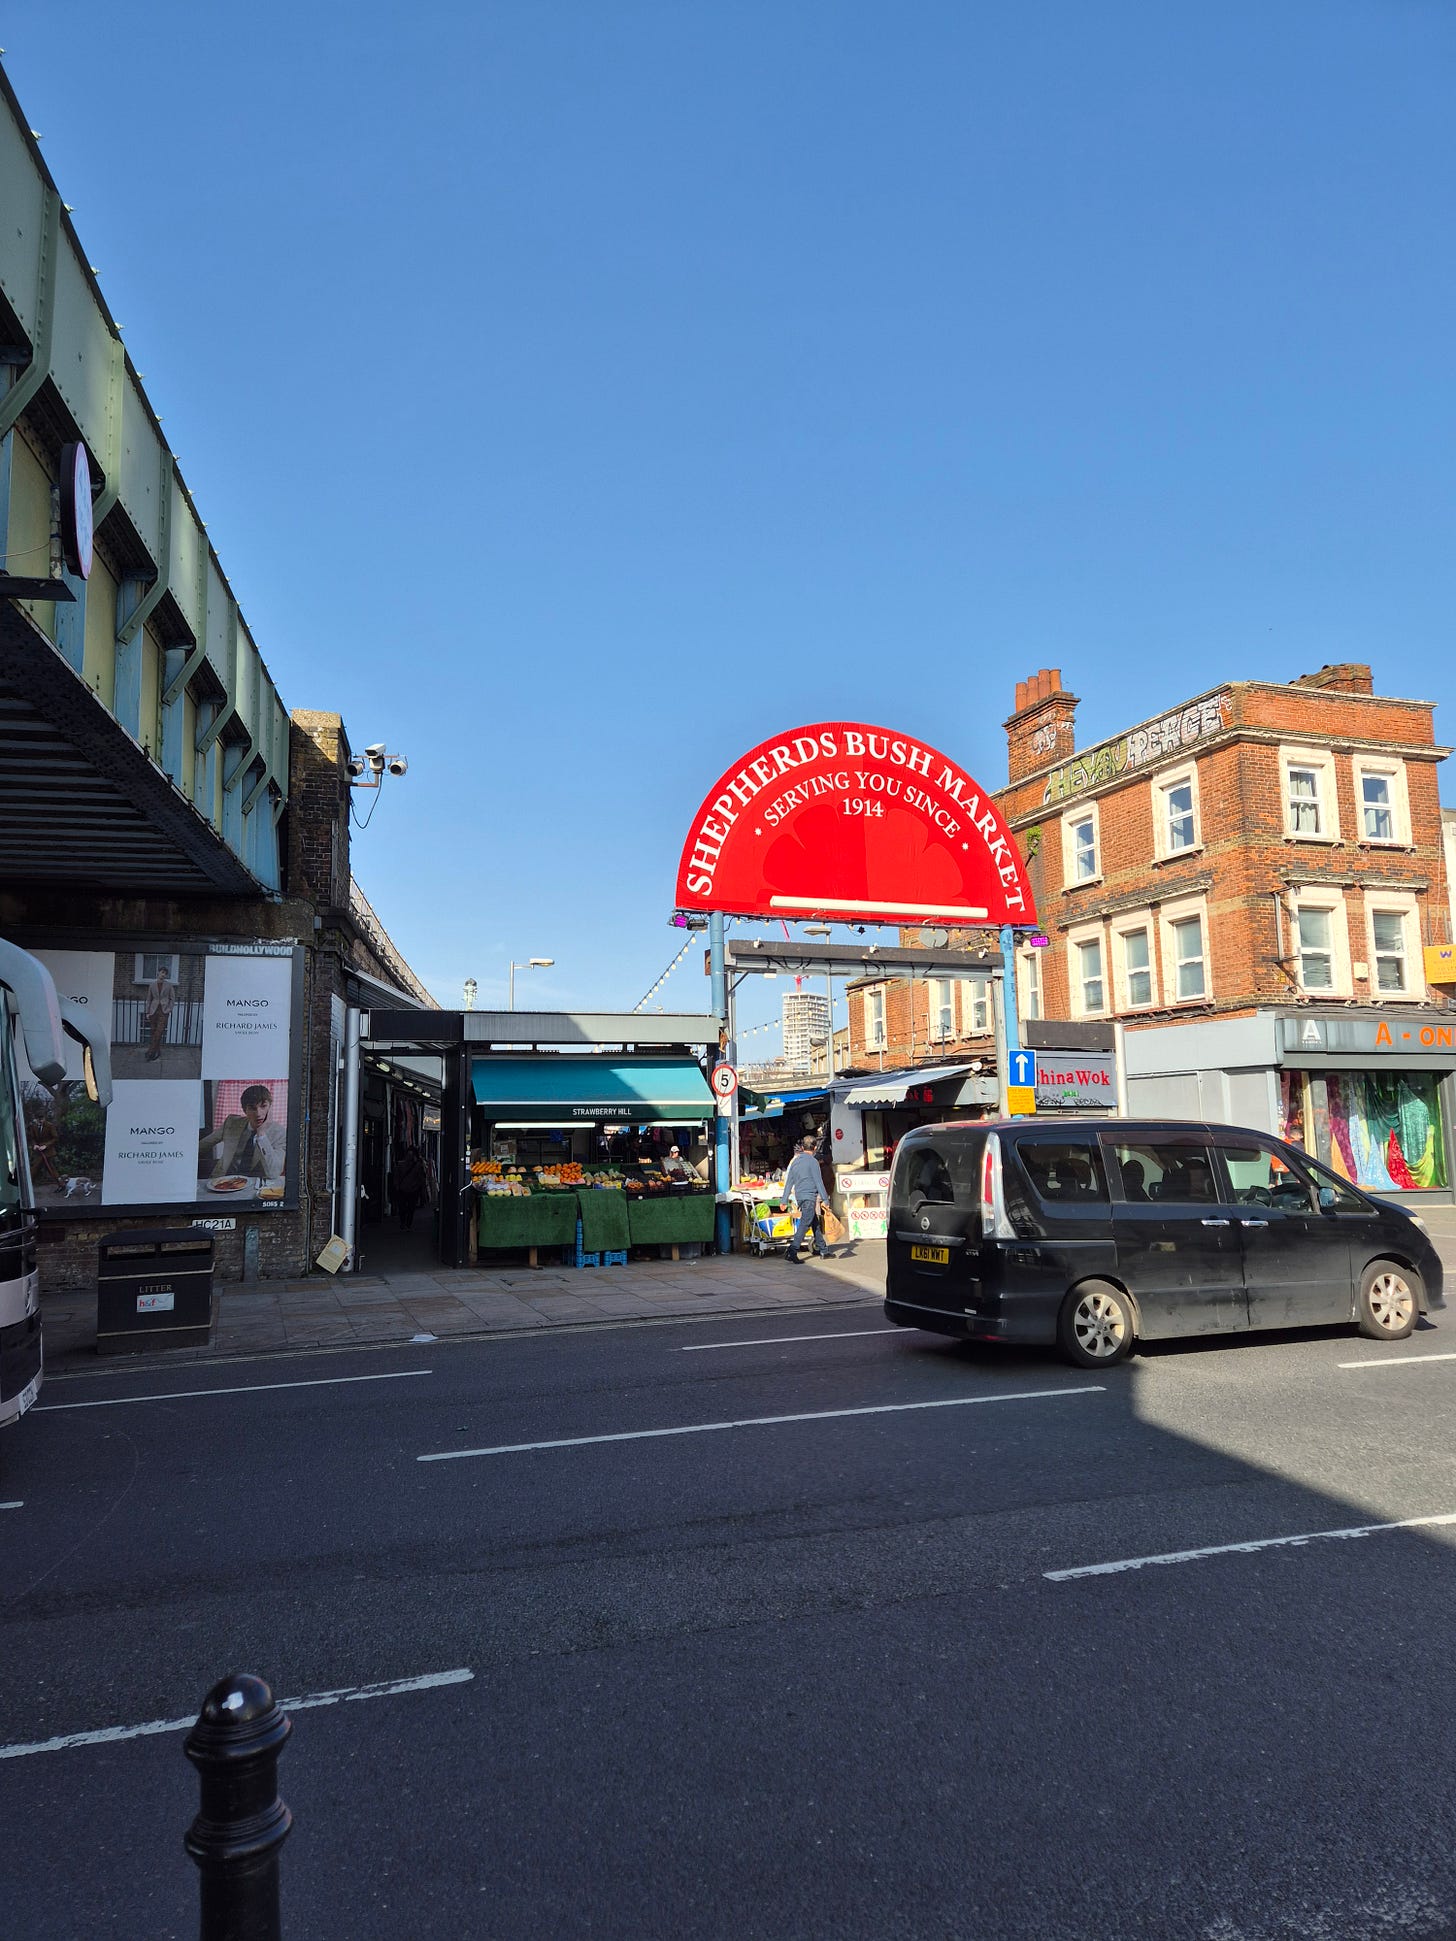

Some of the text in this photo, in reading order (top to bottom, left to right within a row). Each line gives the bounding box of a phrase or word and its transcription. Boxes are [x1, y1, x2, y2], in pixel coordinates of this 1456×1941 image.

[763, 771, 961, 839] SERVING YOU SINCE
[843, 798, 884, 818] 1914
[686, 731, 1026, 912] SHEPHERDS BUSH MARKET
[226, 999, 269, 1007] MANGO
[216, 1022, 278, 1030] RICHARD JAMES
[1375, 1021, 1393, 1046] A
[1419, 1026, 1456, 1047] ON
[720, 1074, 729, 1088] 5
[572, 1108, 632, 1116] STRAWBERRY HILL
[130, 1127, 175, 1135] MANGO
[118, 1151, 184, 1160] RICHARD JAMES
[195, 1219, 232, 1229] HC21A
[139, 1284, 172, 1293] LITTER
